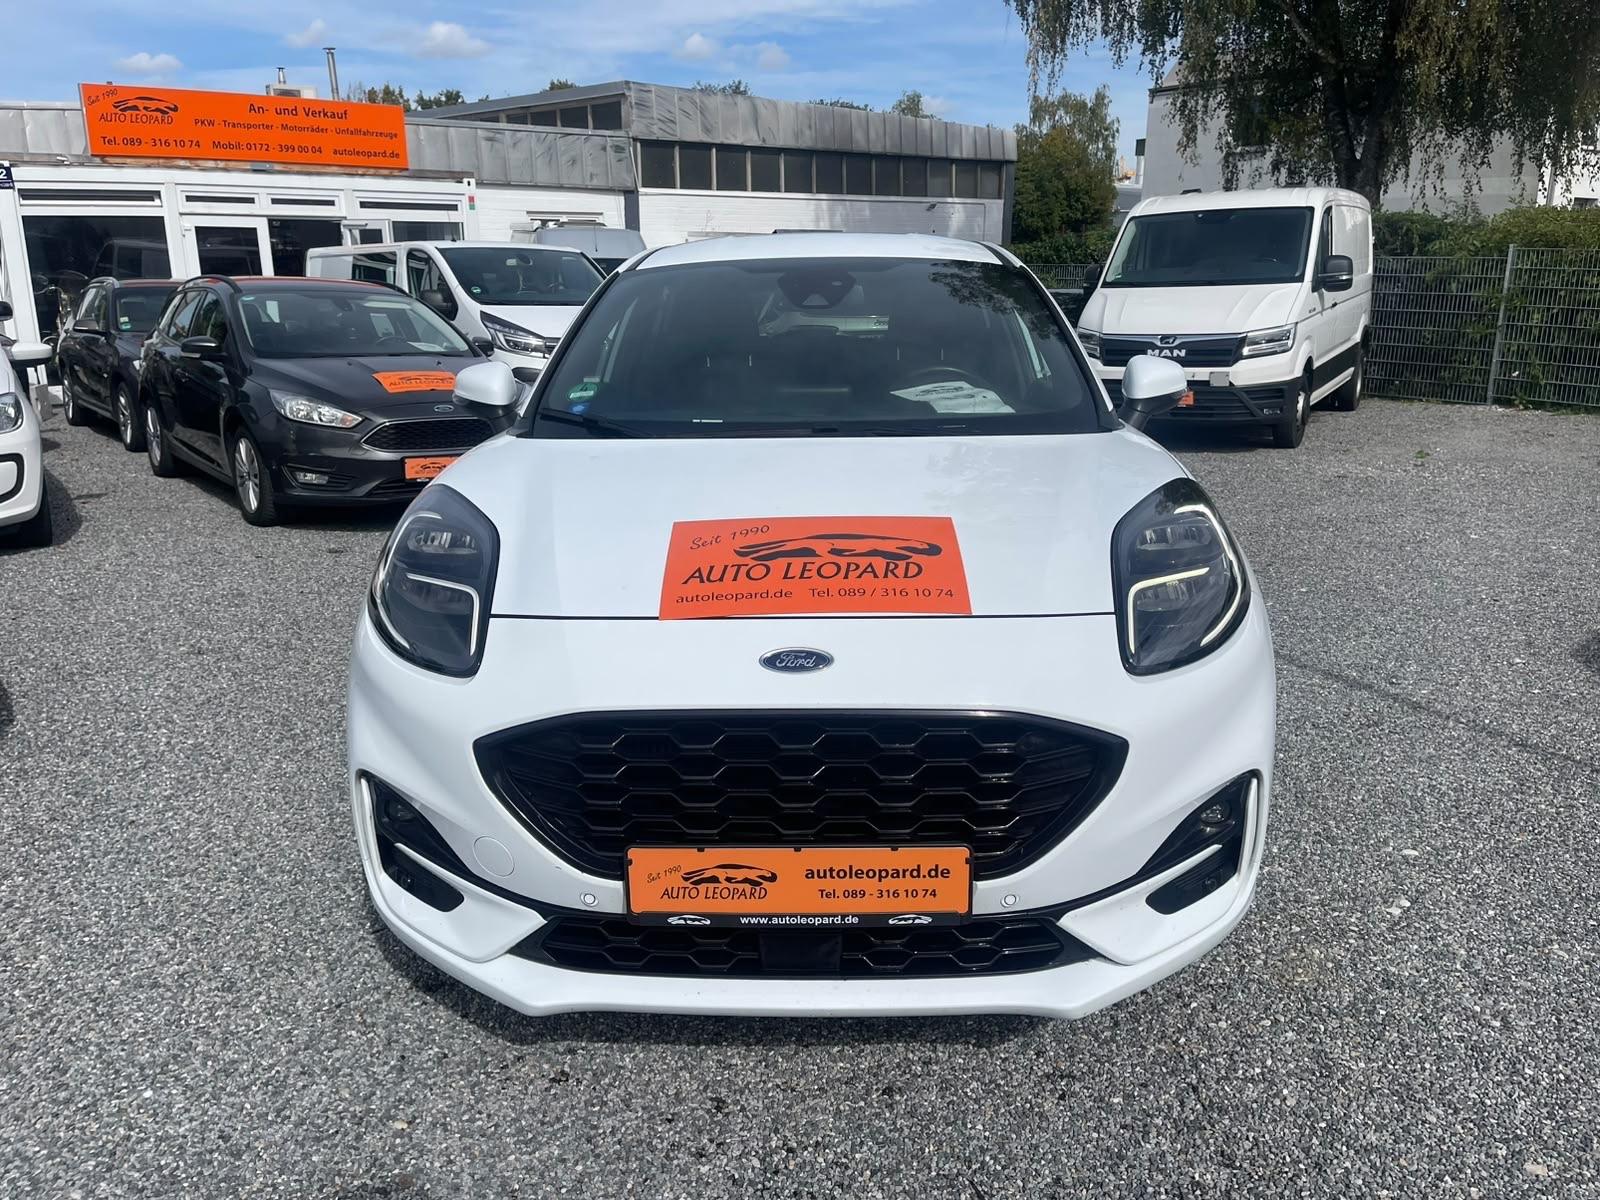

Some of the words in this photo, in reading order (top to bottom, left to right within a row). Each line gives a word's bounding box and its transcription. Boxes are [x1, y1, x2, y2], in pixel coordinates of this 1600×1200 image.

[87, 94, 100, 106] Seit
[102, 88, 118, 100] 1990
[99, 113, 127, 123] AUTO
[129, 113, 174, 125] LEOPARD
[249, 103, 269, 114] An-
[275, 105, 298, 117] und
[303, 106, 348, 119] Verkauf
[194, 118, 215, 127] PKW
[222, 120, 274, 131] Transporter
[281, 123, 328, 134] Motorräder
[335, 127, 398, 140] Unfallfahrzeuge
[101, 136, 120, 146] Tel.
[122, 137, 142, 146] 089
[151, 138, 171, 148] 316
[173, 139, 186, 148] 10
[188, 139, 201, 149] 74
[246, 142, 270, 152] 0172
[278, 144, 296, 153] 399
[297, 145, 309, 154] 00
[311, 146, 323, 154] 04
[333, 148, 400, 159] autoleopard.de
[1146, 349, 1186, 357] MAN
[689, 535, 722, 550] Seit
[731, 524, 770, 540] 1990
[681, 562, 771, 585] AUTO
[783, 561, 924, 580] LEOPARD
[676, 588, 793, 603] autoleopard.de
[809, 587, 834, 597] Tel.
[838, 587, 866, 597] 089
[881, 587, 909, 597] 316
[914, 588, 932, 597] 10
[936, 588, 954, 597] 74
[775, 652, 817, 667] Ford
[646, 872, 662, 884] Seit
[664, 864, 682, 876] 1990
[804, 863, 951, 883] autoleopard.de
[660, 886, 699, 900] AUTO
[704, 886, 768, 900] LEOPARD
[818, 889, 840, 899] Tel.
[843, 889, 866, 899] 089
[876, 889, 900, 899] 316
[904, 889, 918, 898] 10
[921, 889, 937, 898] 74
[739, 915, 859, 926] www.autoleopard.de
